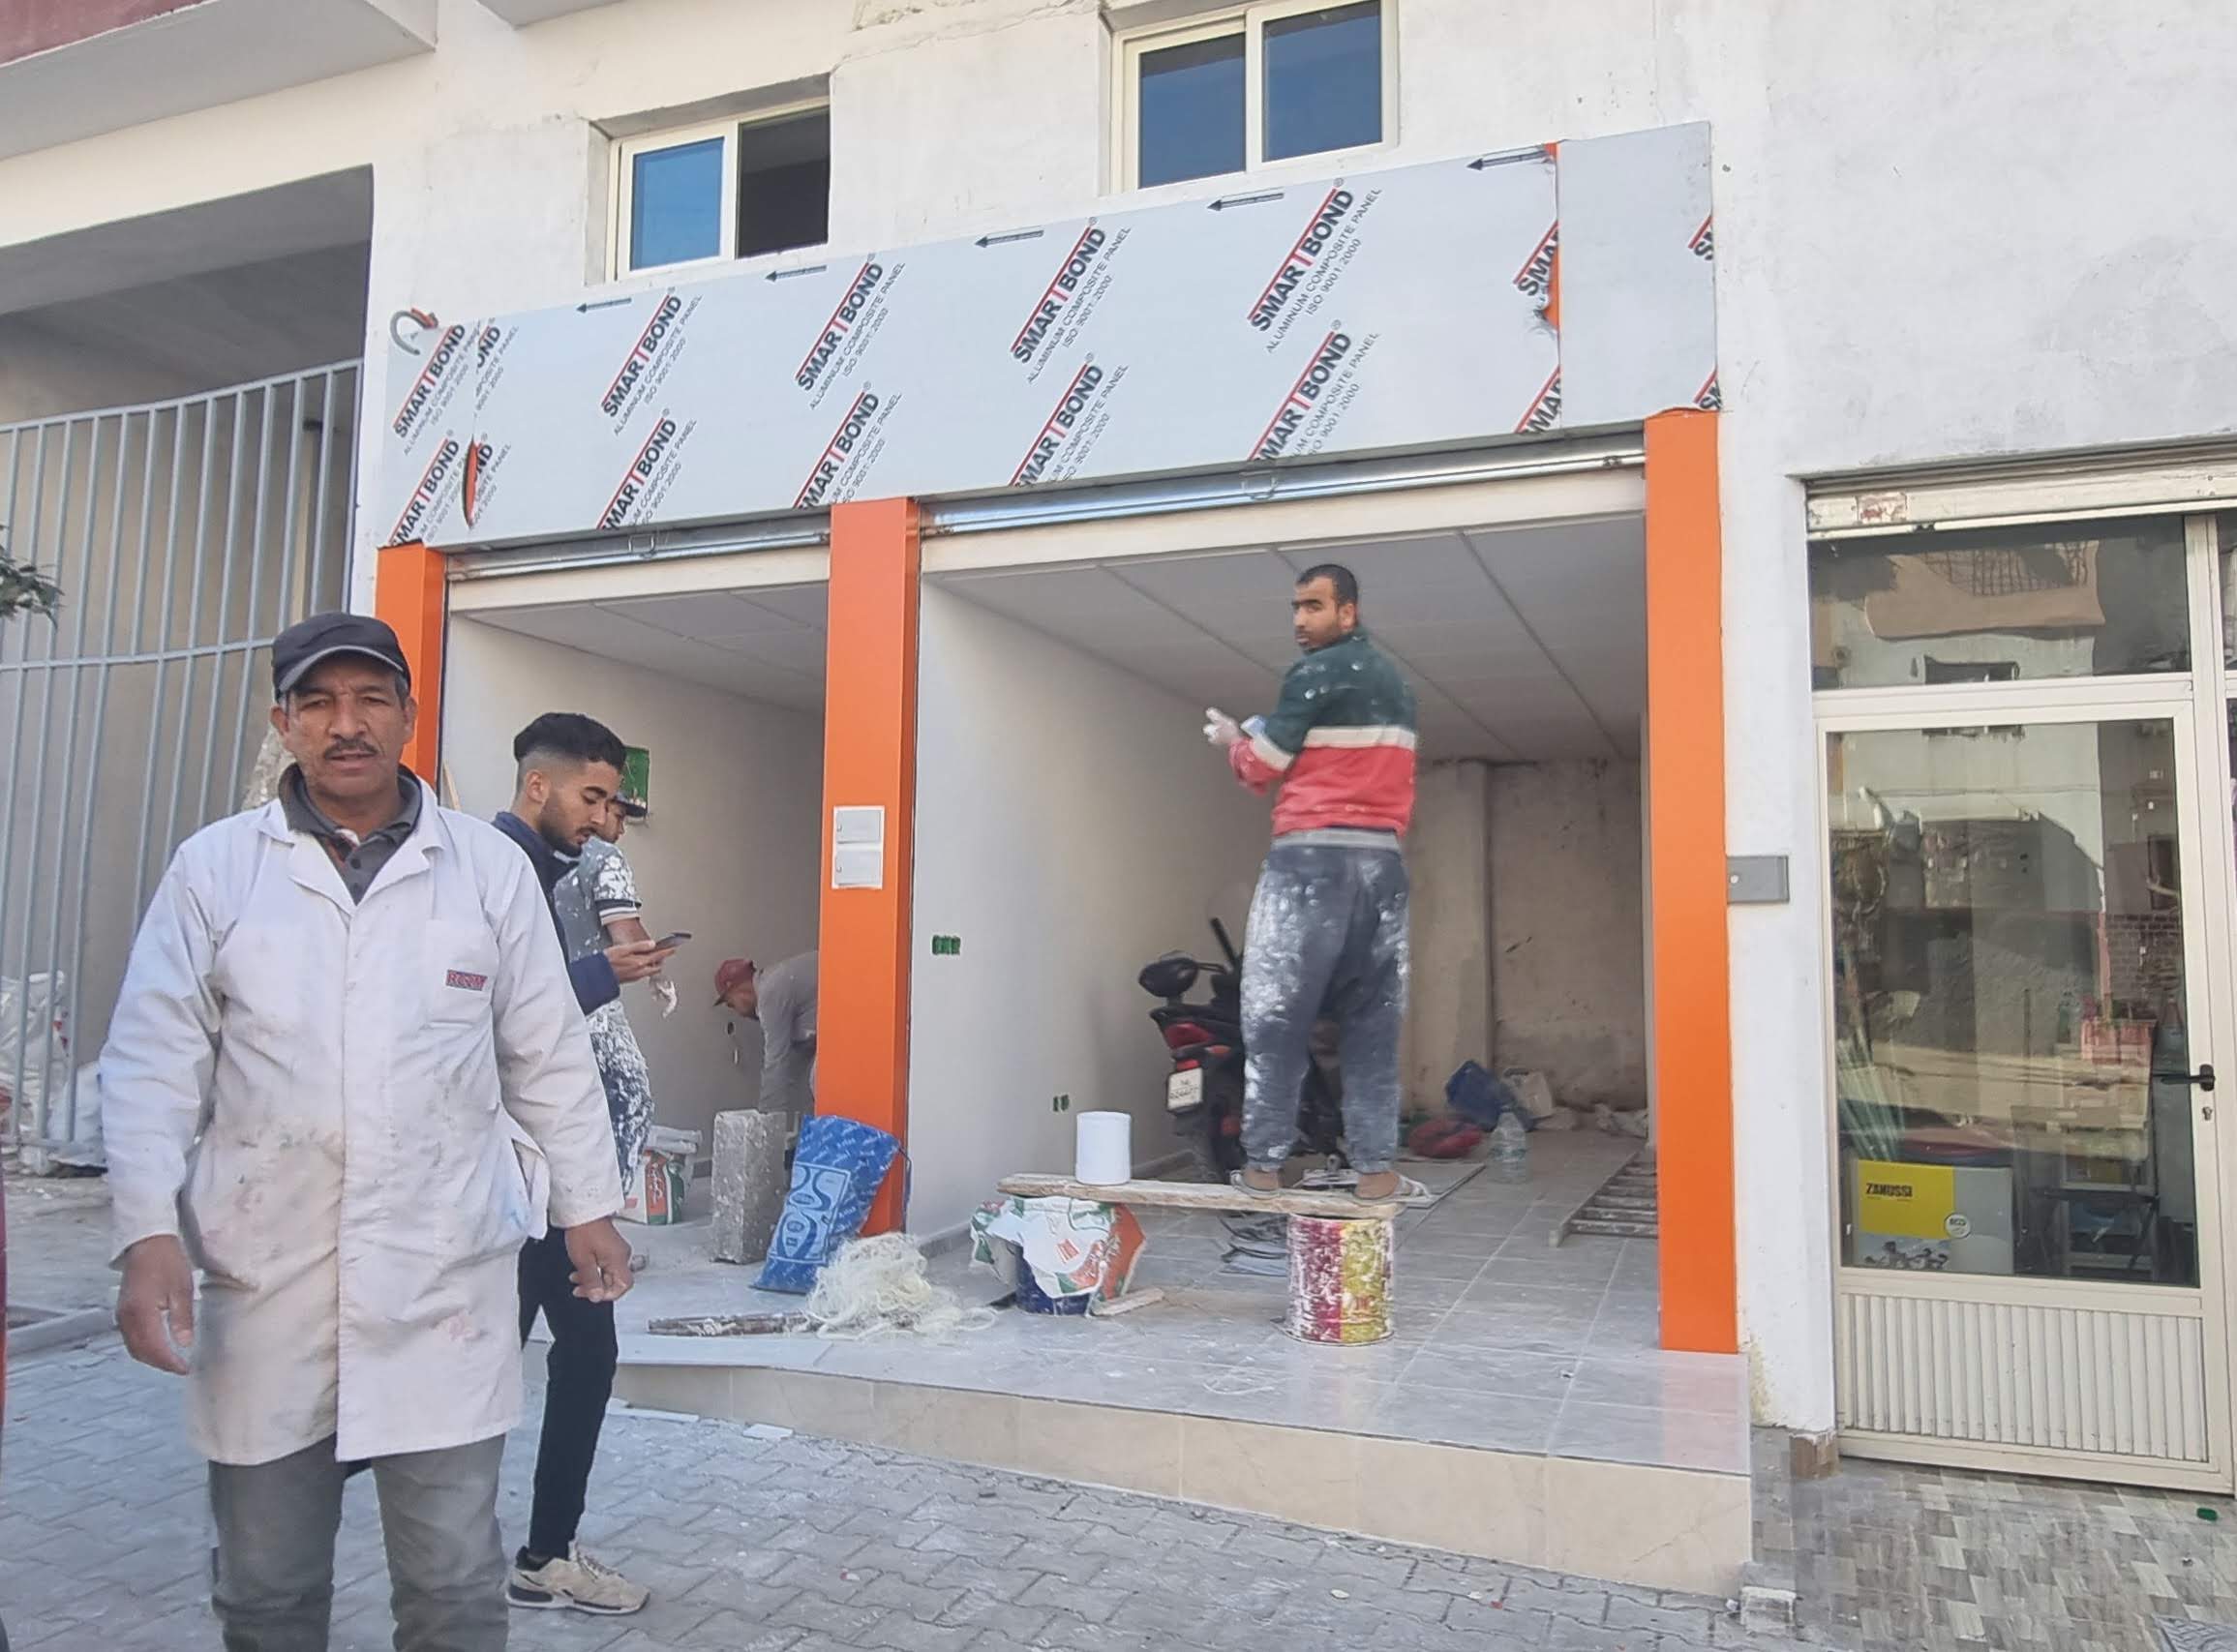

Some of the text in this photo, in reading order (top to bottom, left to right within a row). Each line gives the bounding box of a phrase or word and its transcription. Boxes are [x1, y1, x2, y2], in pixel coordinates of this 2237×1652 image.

[1027, 227, 1131, 384] ALUMINUM COMPOSITE PANEL
[1266, 188, 1381, 353] ALUMINUM COMPOSITE PANEL
[1306, 294, 1324, 315] ISO
[431, 353, 465, 406] COMPOSITE
[614, 295, 702, 436] ALUMINUM COMPOSITE PANEL
[810, 262, 906, 410] ALUMINUM COMPOSITE PANEL
[843, 357, 858, 376] ISO
[1062, 328, 1079, 348] ISO
[1060, 365, 1128, 465] COMPOSITE PANEL
[1248, 331, 1352, 460] MARTBOND
[1304, 333, 1378, 437] COMPOSITE PANEL
[639, 420, 697, 508] COMPOSITE PANEL
[839, 393, 902, 487] COMPOSITE PANEL
[1865, 1183, 1913, 1198] ZANUSSI
